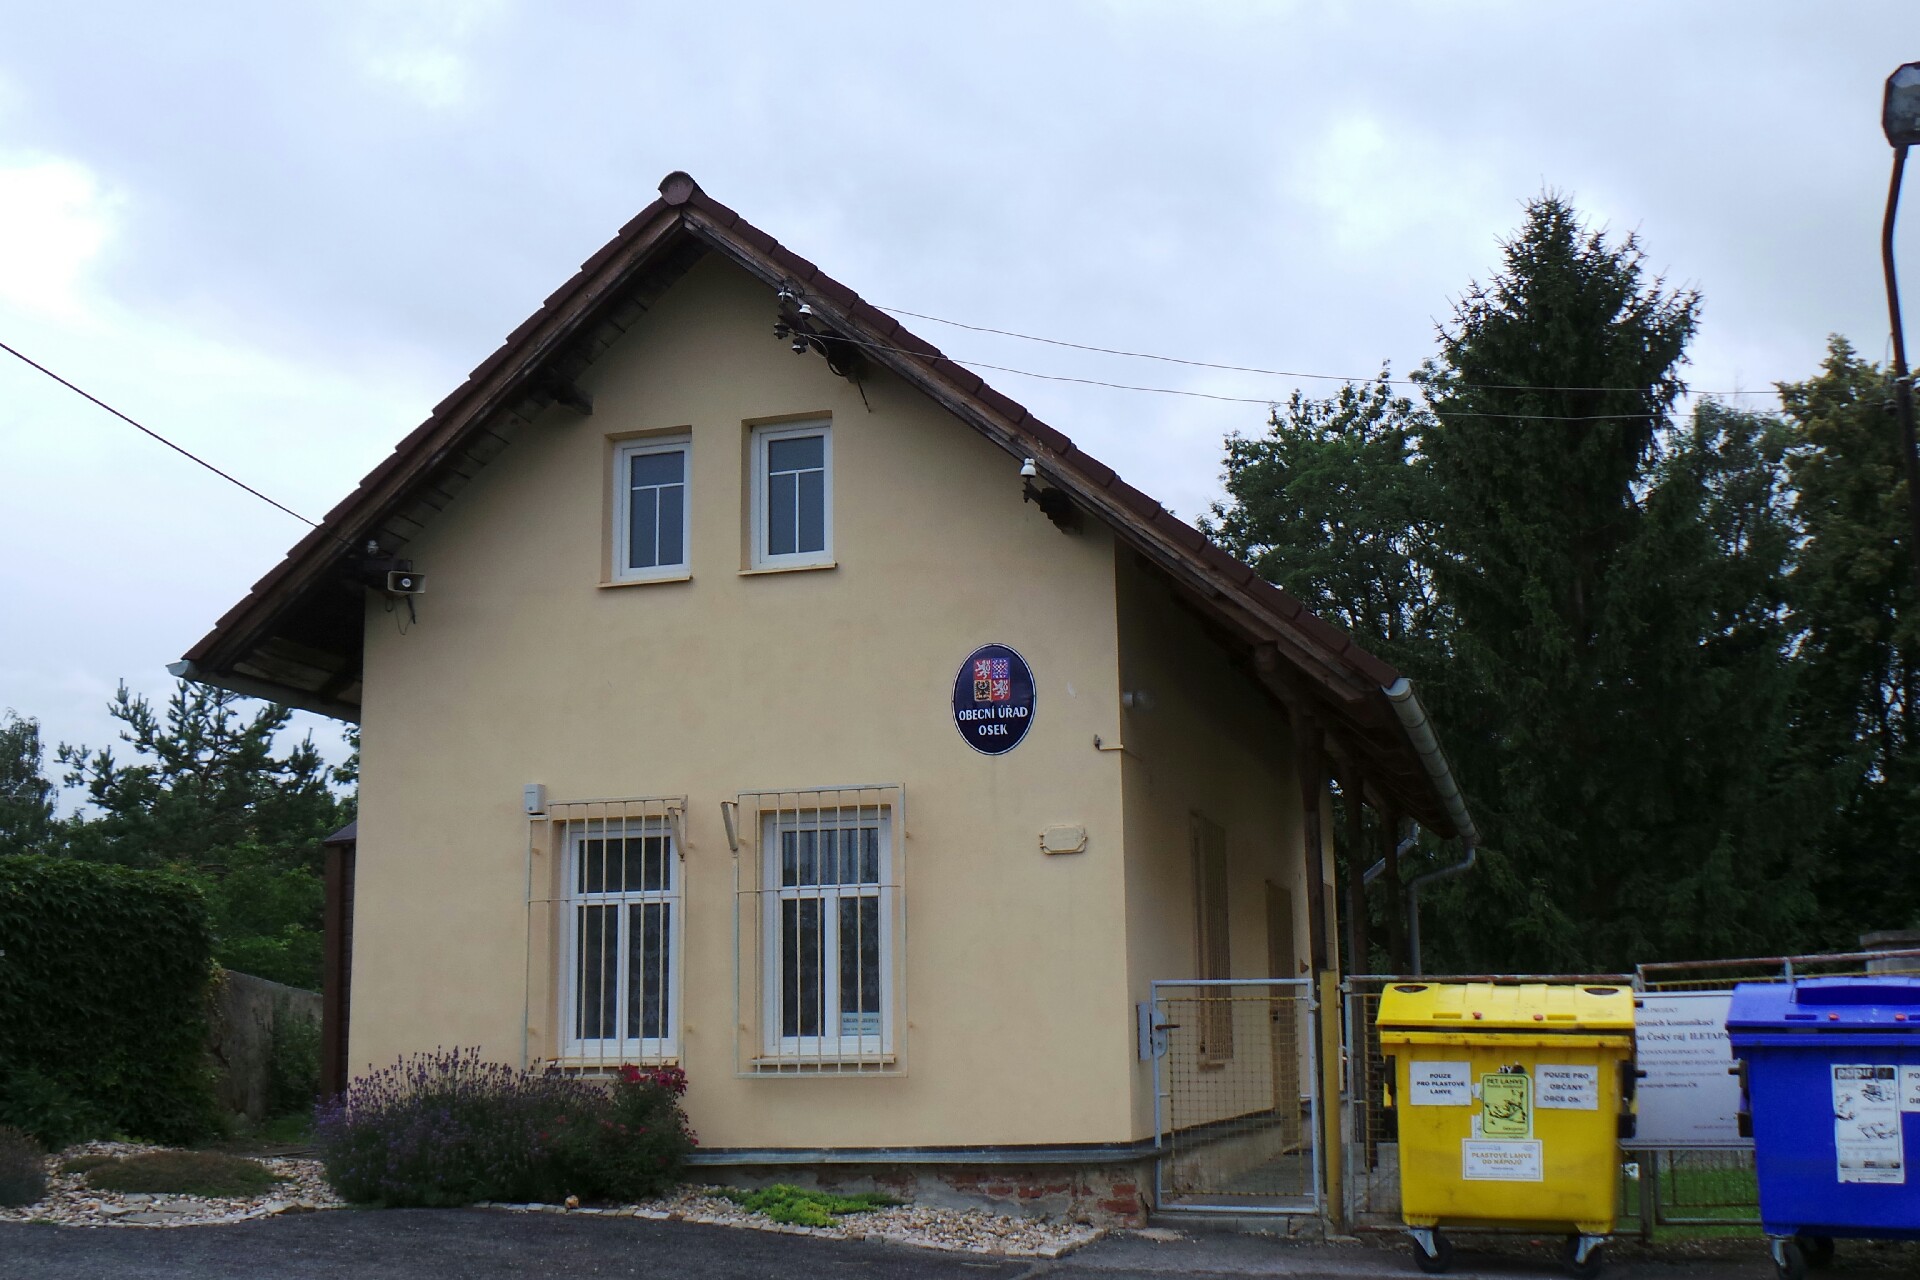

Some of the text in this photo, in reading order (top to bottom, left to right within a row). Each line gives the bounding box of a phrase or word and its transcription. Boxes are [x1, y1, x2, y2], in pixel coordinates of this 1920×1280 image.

[959, 705, 1029, 721] OBECNÍ ÚŘAD
[978, 724, 1009, 736] OSEK
[1543, 1071, 1589, 1080] POUZE PRO
[1549, 1082, 1583, 1091] OBČANY
